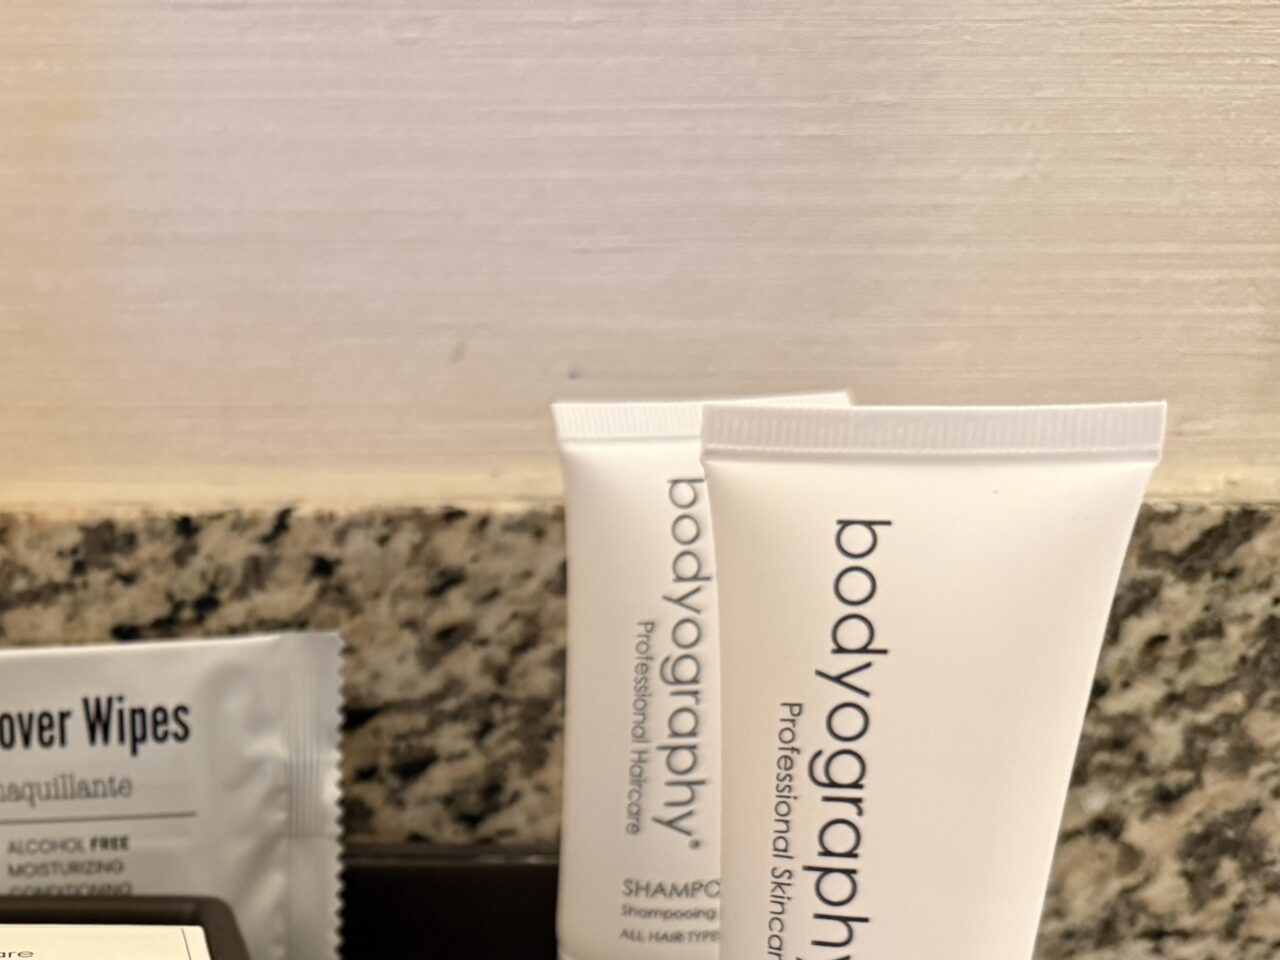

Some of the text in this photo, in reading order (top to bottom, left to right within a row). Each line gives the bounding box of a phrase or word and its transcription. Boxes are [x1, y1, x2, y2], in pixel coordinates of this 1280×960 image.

[82, 694, 191, 757] Wipes
[625, 619, 656, 836] Professional Haircare
[771, 701, 803, 861] Professional
[7, 836, 131, 855] ALCOHOL FREE
[8, 859, 125, 878] MOISTURIZING
[622, 878, 720, 898] SHAMPO
[620, 928, 721, 943] ALL HAIR TYPE
